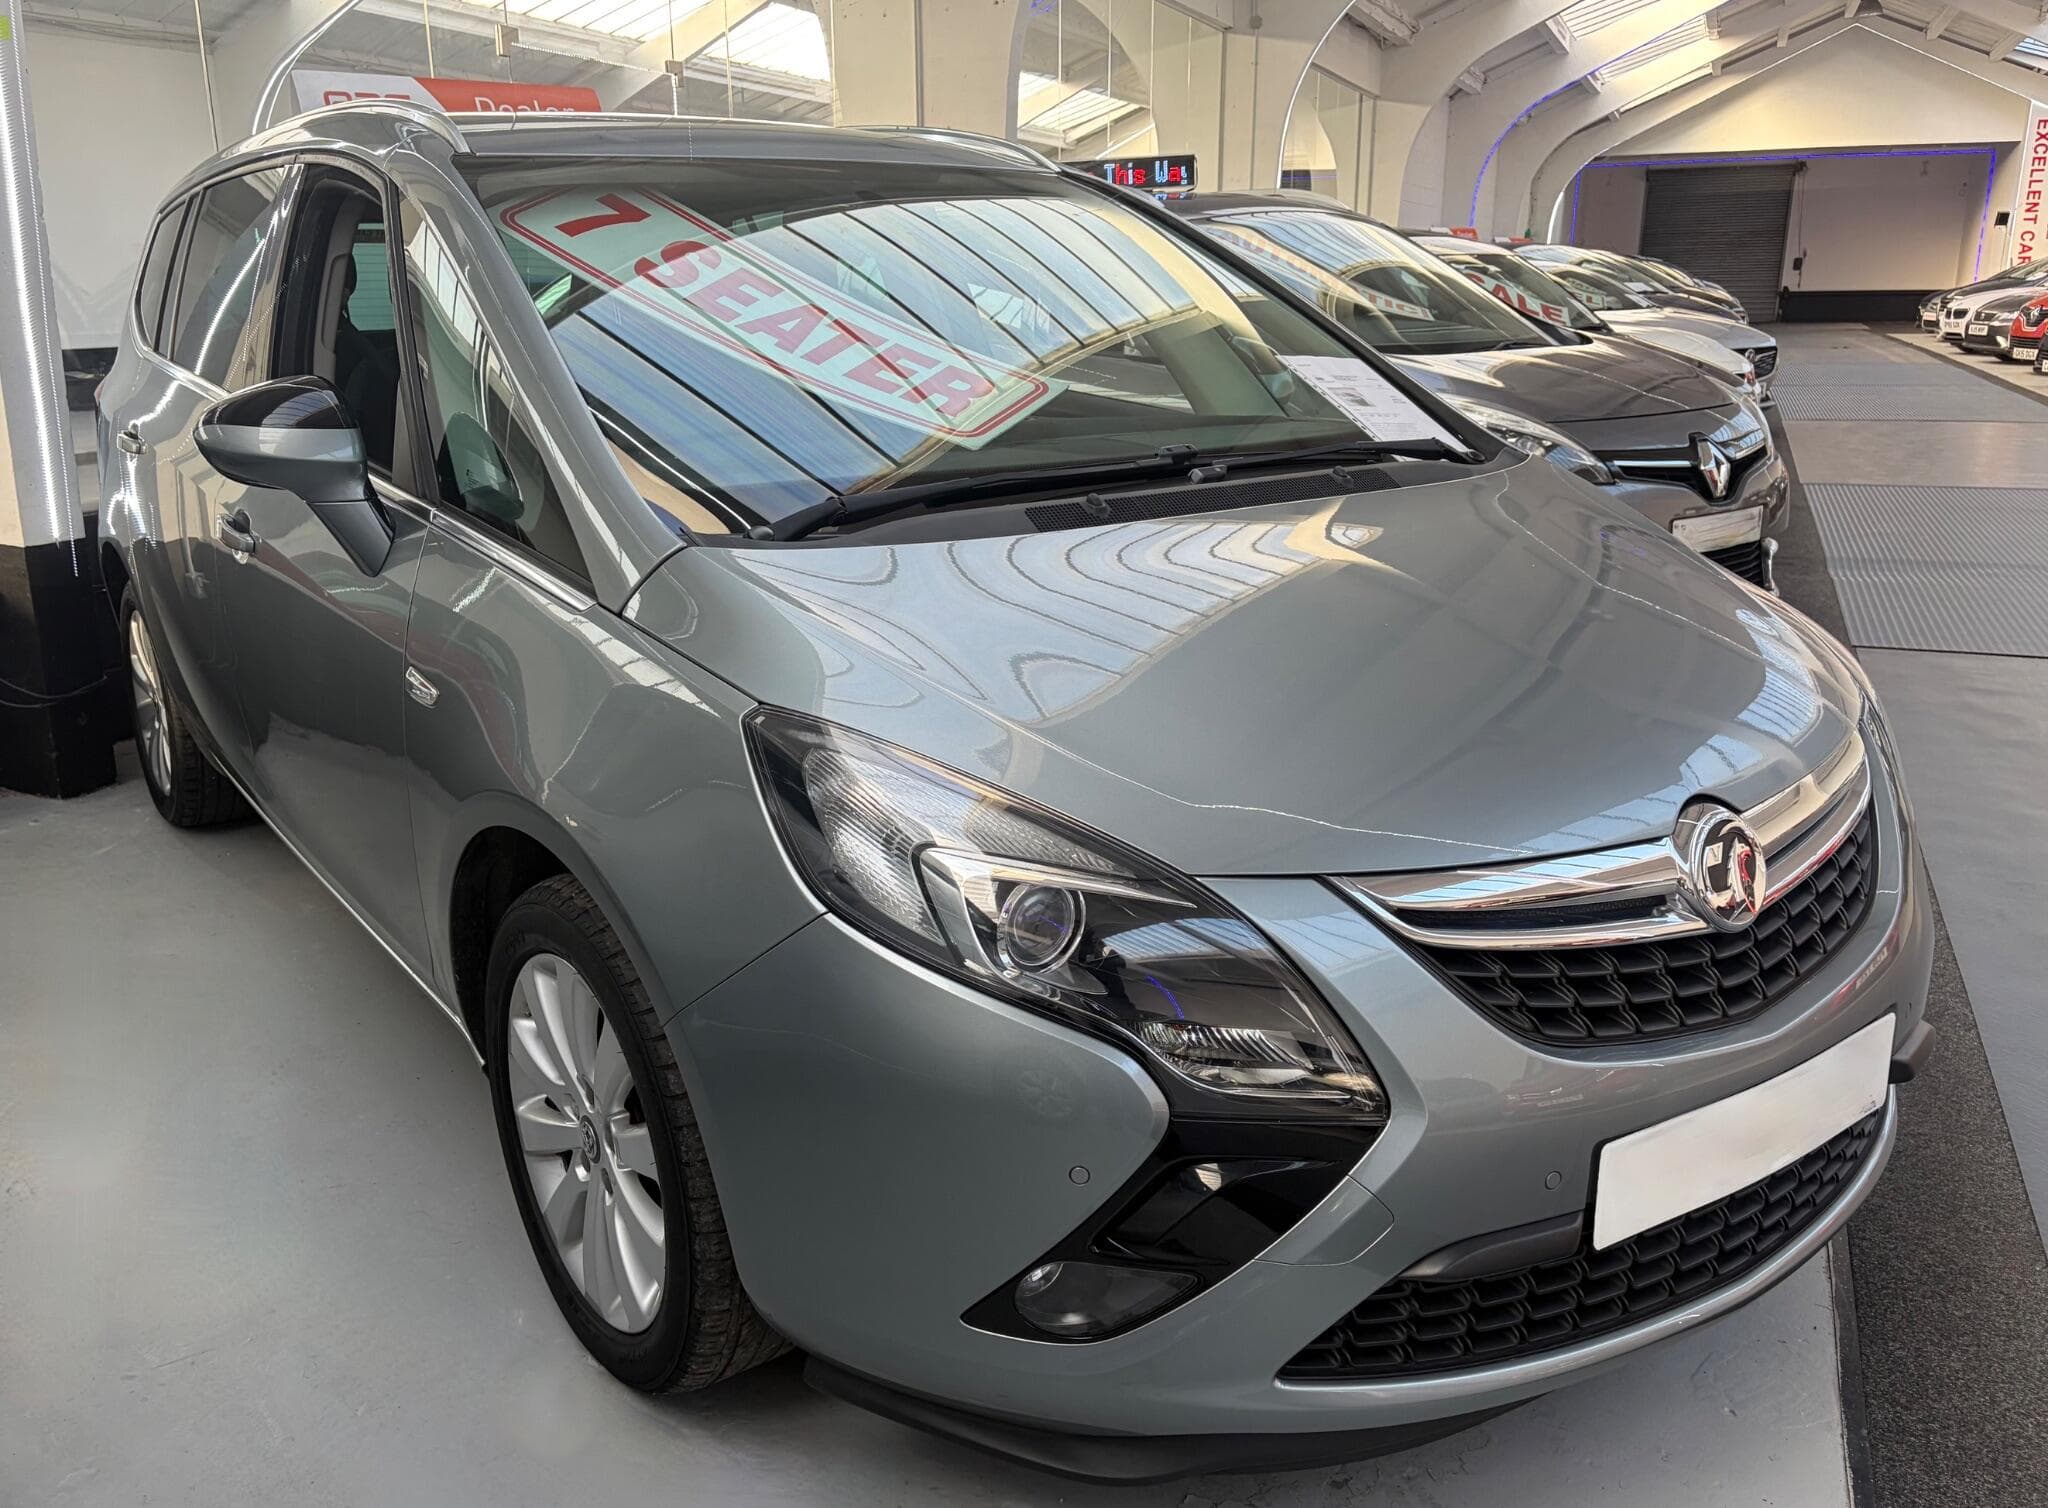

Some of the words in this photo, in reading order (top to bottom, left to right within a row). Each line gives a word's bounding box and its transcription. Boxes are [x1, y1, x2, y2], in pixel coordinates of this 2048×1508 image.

[1103, 162, 1147, 185] This
[2023, 119, 2048, 224] EXCELLENT
[555, 192, 651, 238] 7
[634, 240, 997, 418] SEATER
